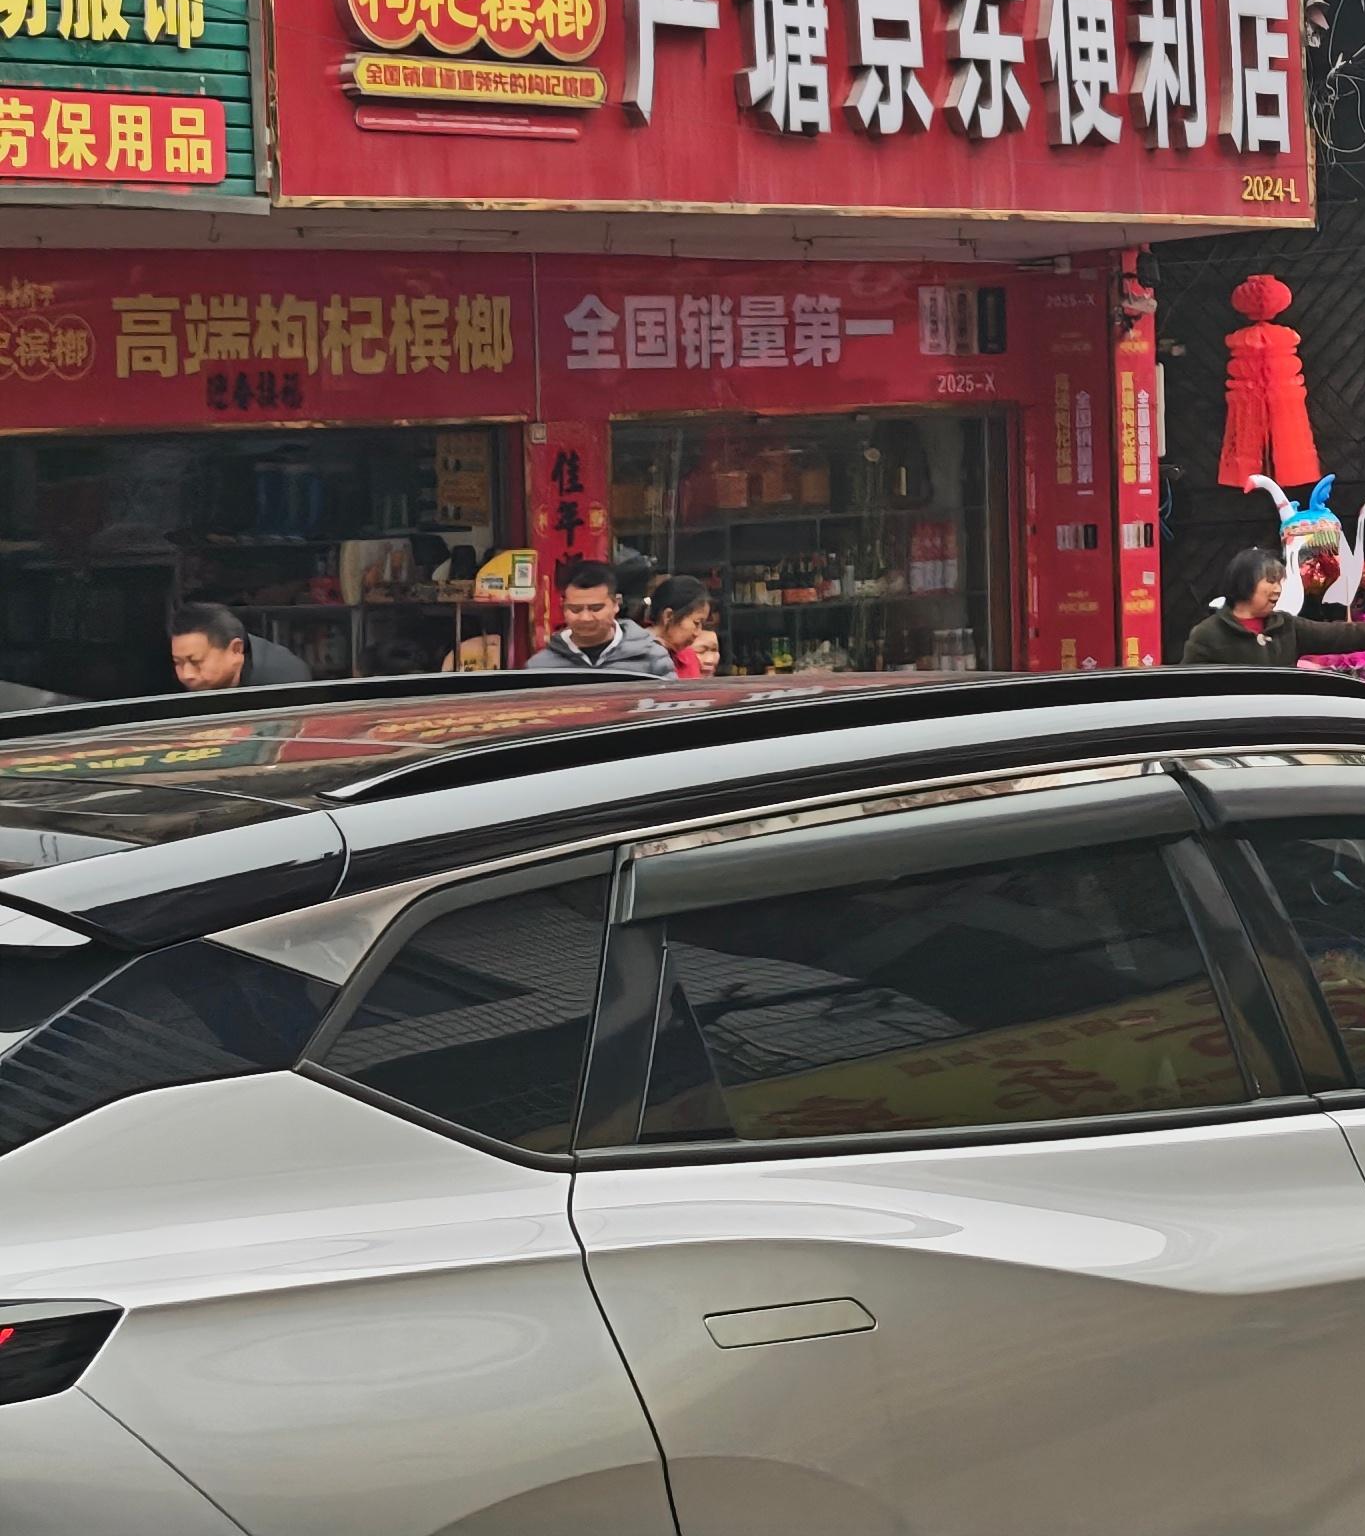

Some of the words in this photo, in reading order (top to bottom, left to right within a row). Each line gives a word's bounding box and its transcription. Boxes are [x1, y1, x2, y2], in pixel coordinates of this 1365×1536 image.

[0, 97, 213, 176] 劳保用品
[1241, 175, 1301, 203] 2024-L
[111, 293, 513, 379] 高端枸杞槟榔
[564, 293, 894, 369] 全国销量第一
[937, 373, 996, 394] 2025-X
